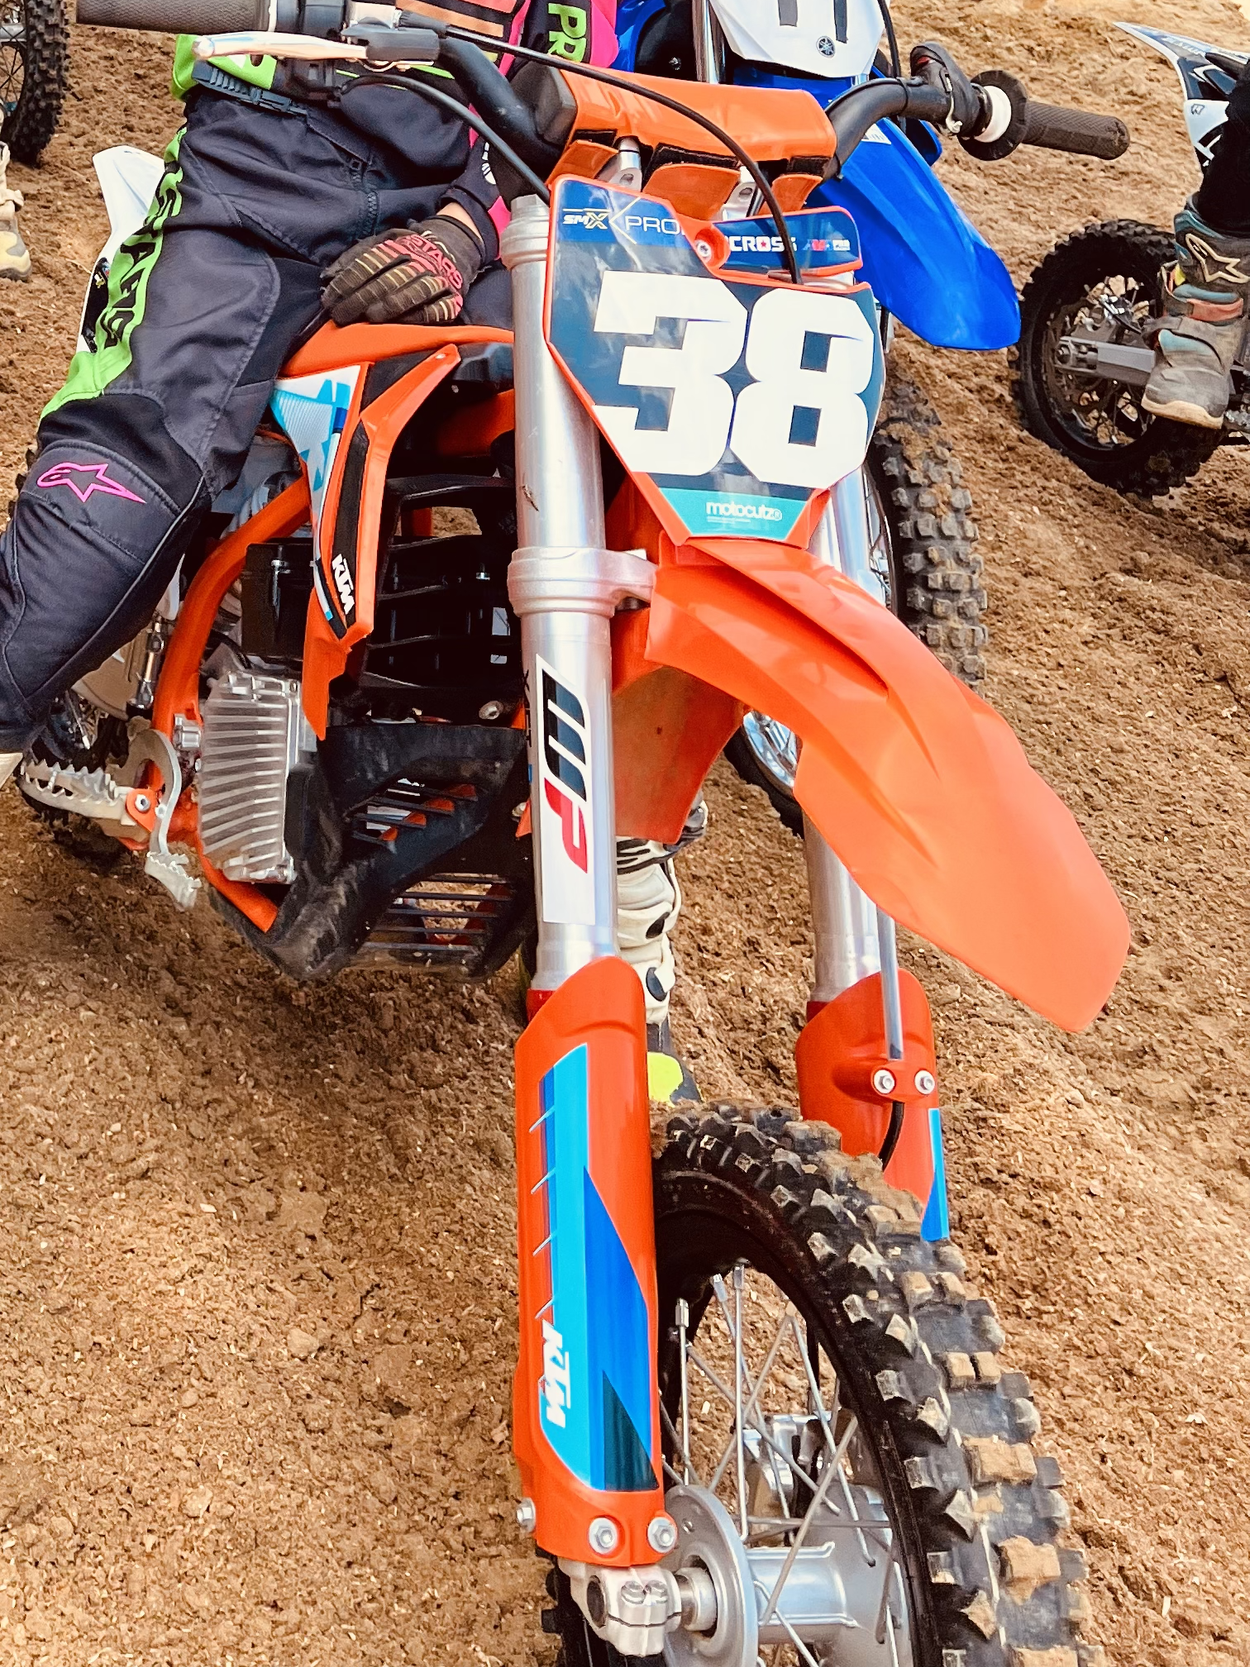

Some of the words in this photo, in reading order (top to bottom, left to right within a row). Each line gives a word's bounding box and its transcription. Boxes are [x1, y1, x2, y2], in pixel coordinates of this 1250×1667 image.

[726, 235, 798, 253] CROSS
[592, 270, 876, 489] 38
[332, 553, 356, 615] KTM
